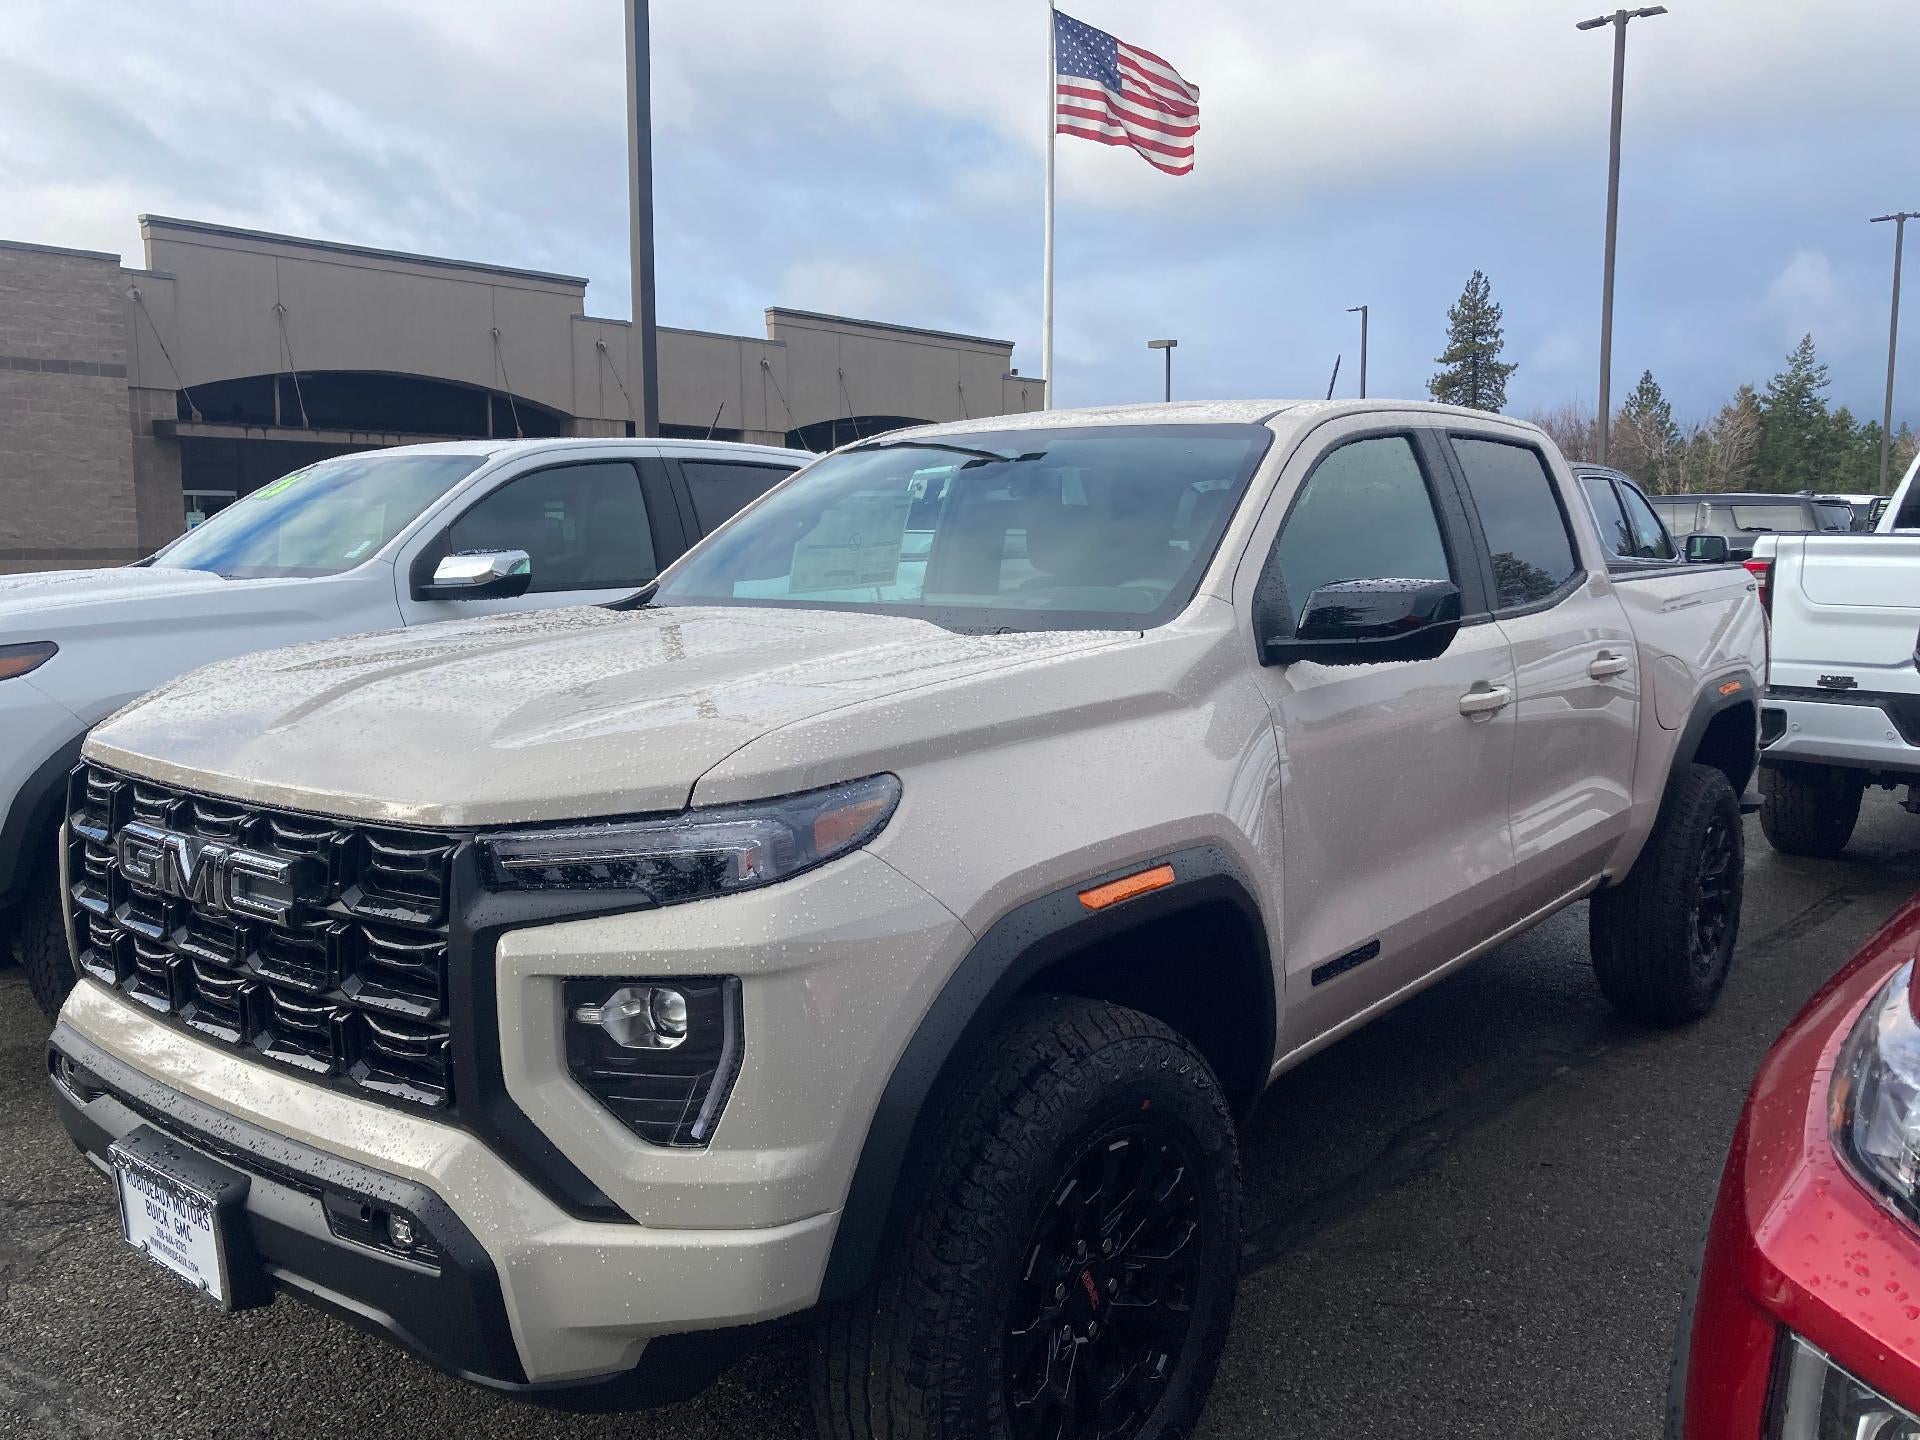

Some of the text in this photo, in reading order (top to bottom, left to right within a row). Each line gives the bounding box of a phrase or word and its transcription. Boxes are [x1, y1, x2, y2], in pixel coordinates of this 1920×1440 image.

[119, 821, 293, 928] GMC
[145, 1199, 193, 1243] BUICK GMC
[172, 1197, 210, 1232] MOTORS
